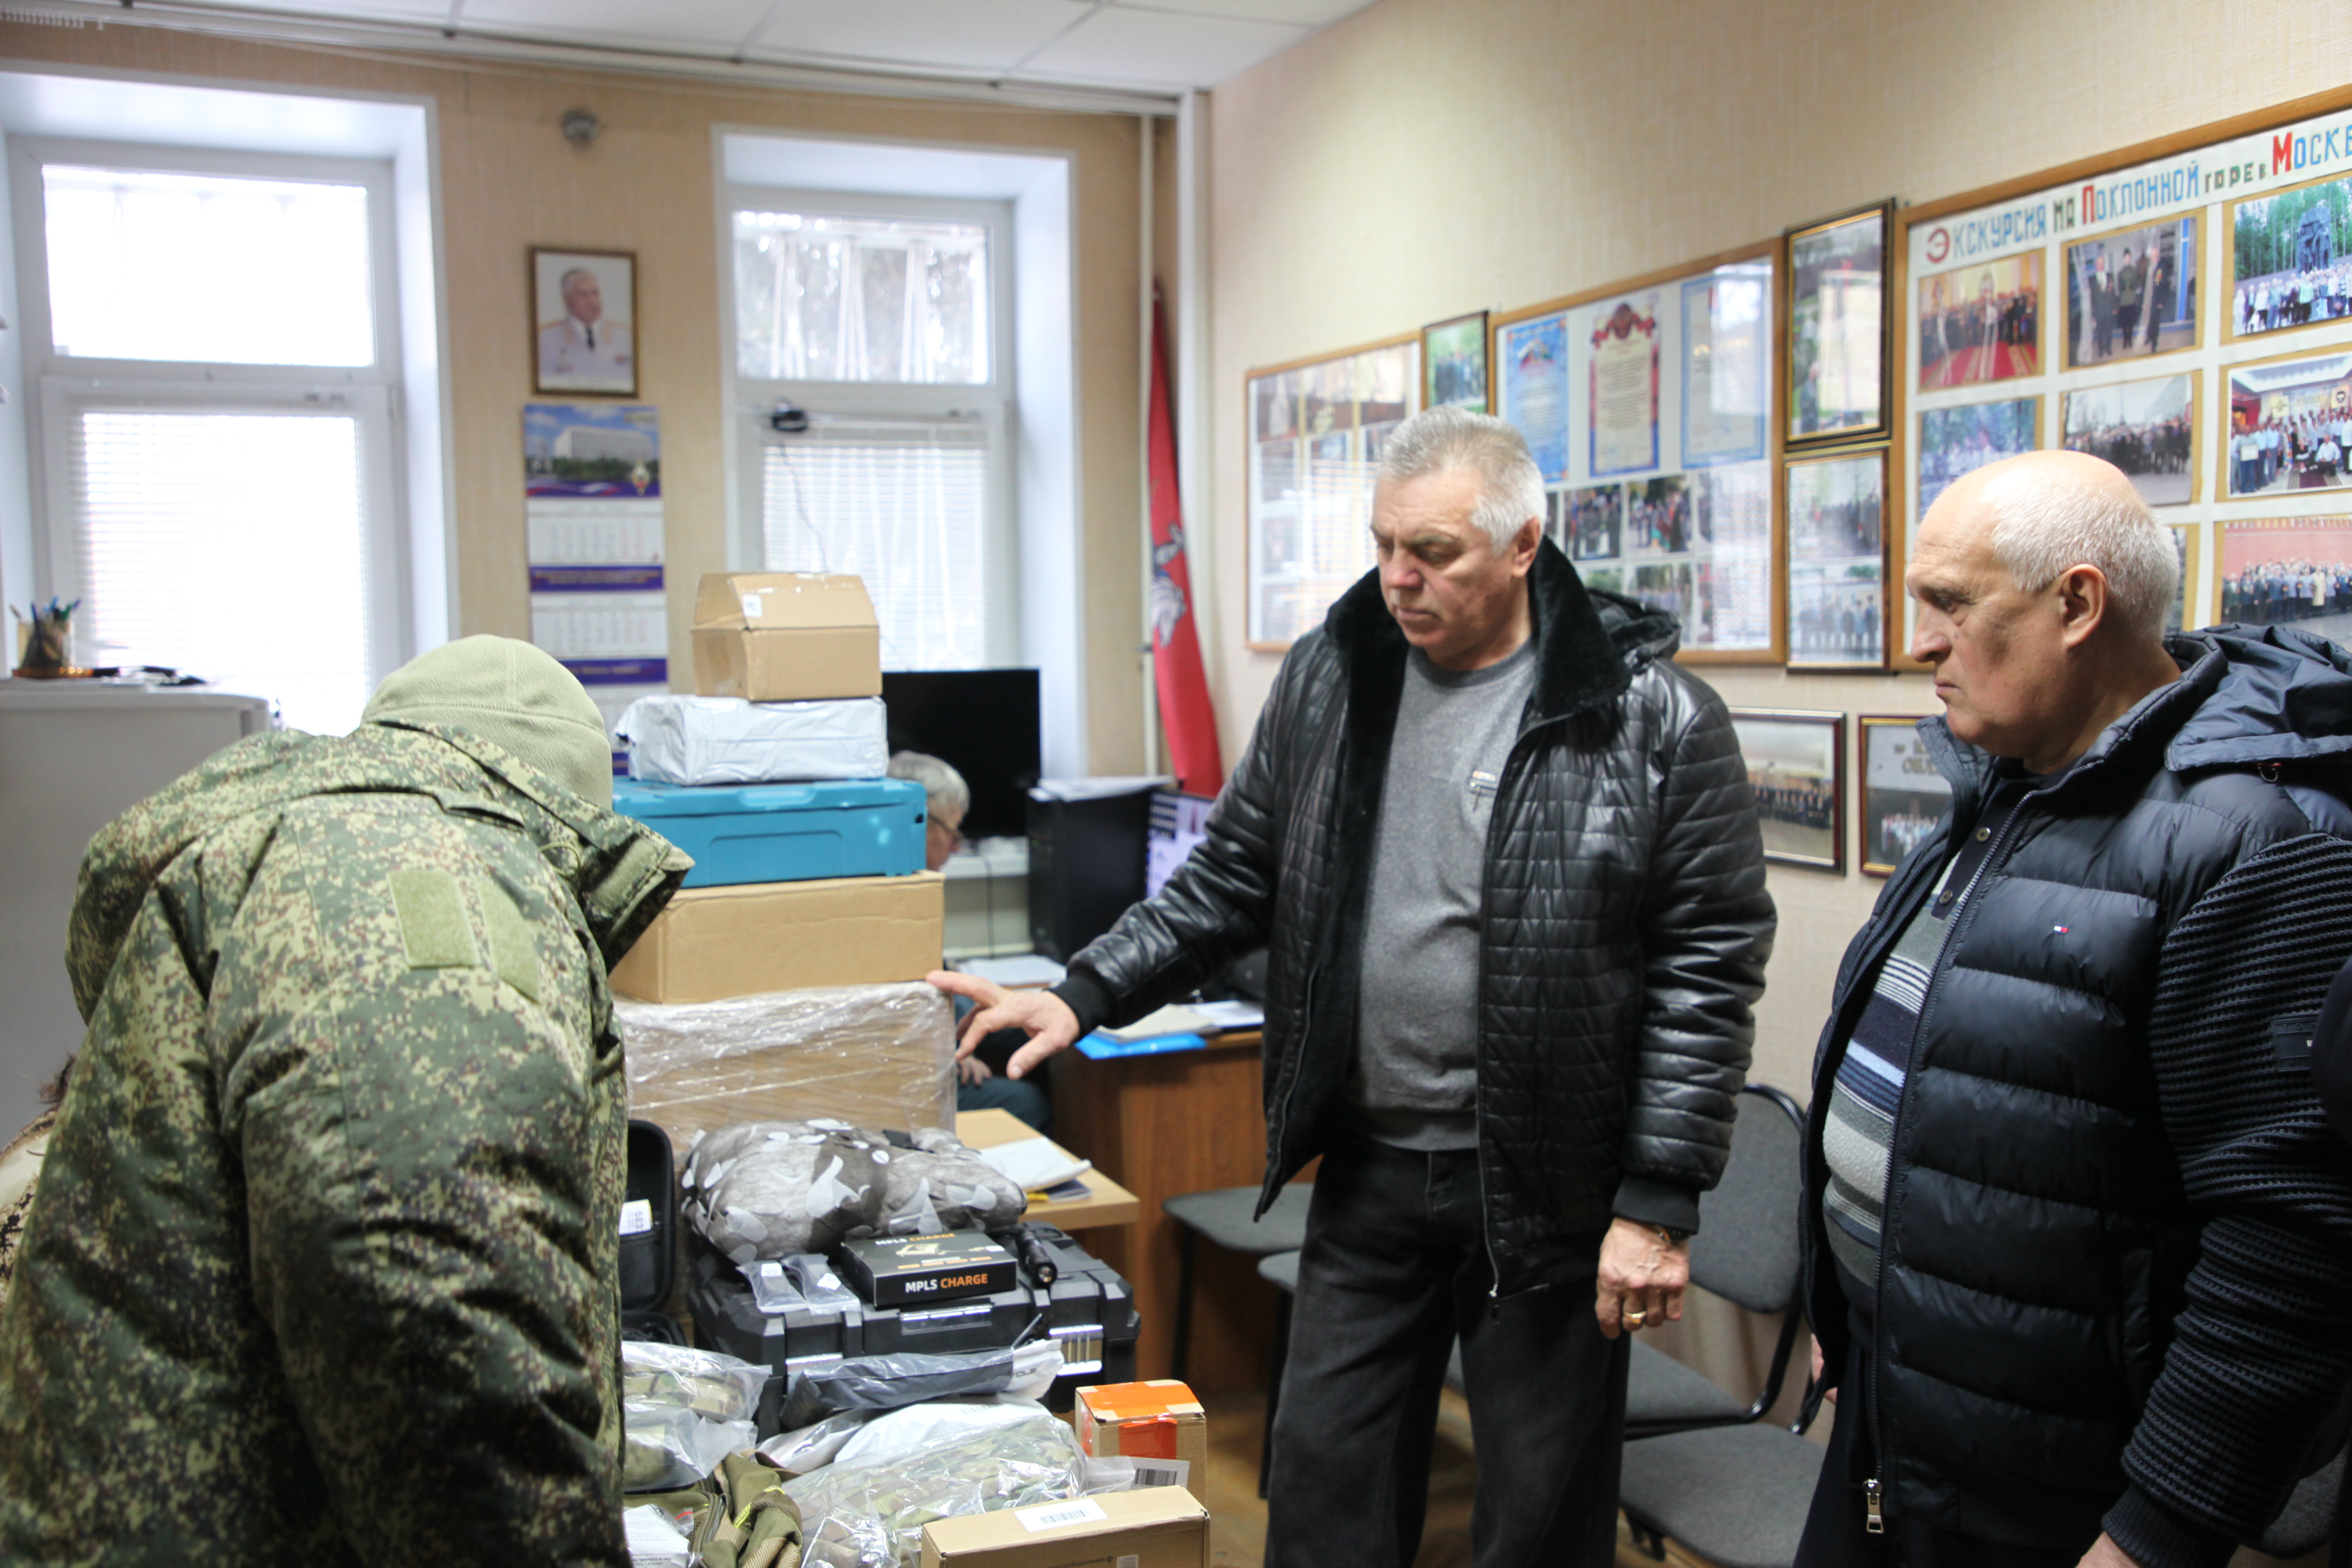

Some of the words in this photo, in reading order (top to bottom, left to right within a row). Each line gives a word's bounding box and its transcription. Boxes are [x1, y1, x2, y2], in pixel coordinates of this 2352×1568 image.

[2082, 160, 2199, 225] ПОКЛОННОЙ
[909, 1233, 957, 1242] CHARGE
[905, 1279, 938, 1293] MPLS
[940, 1273, 988, 1289] CHARGE
